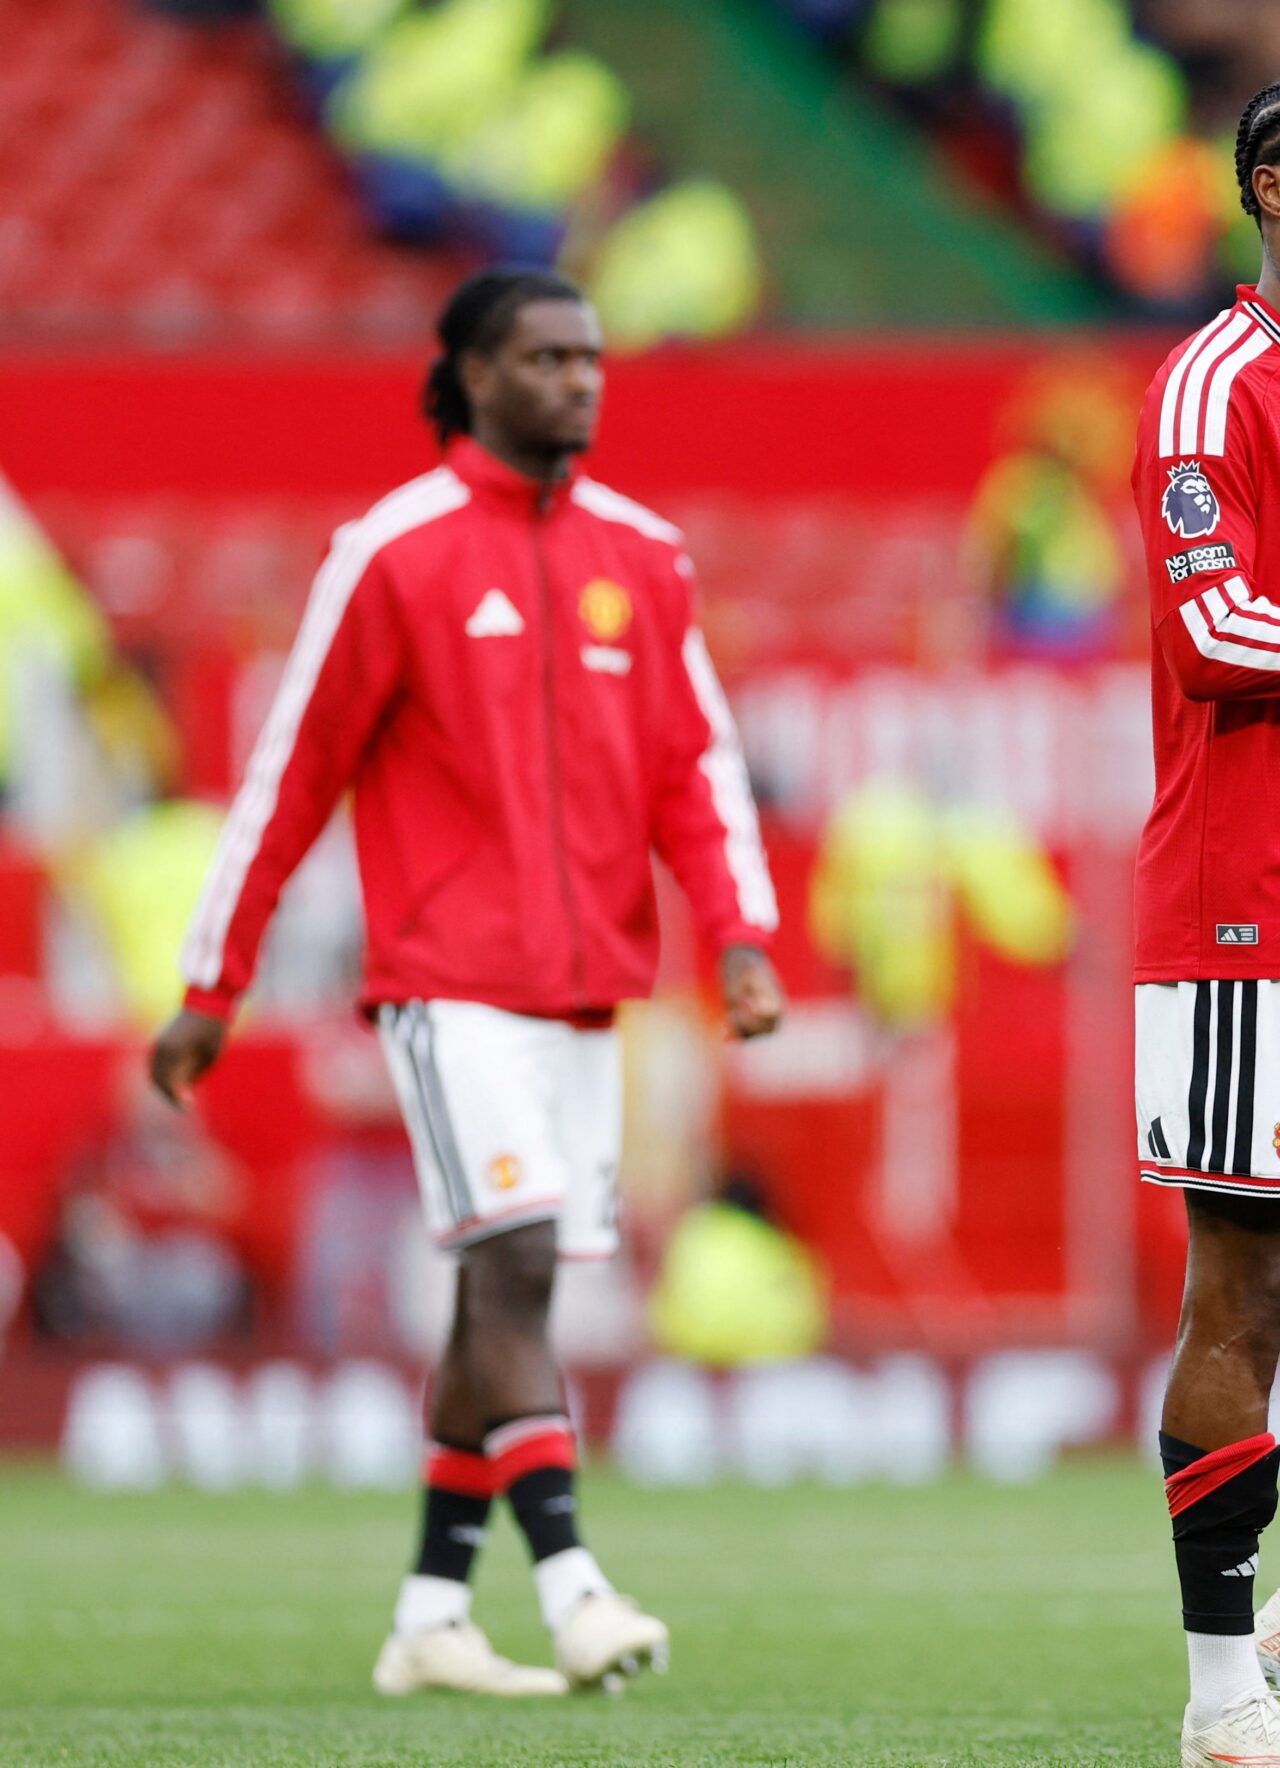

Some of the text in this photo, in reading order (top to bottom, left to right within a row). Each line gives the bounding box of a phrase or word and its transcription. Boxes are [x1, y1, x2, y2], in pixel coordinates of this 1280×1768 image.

[1165, 545, 1227, 572] No room
[1169, 556, 1236, 584] for racism
